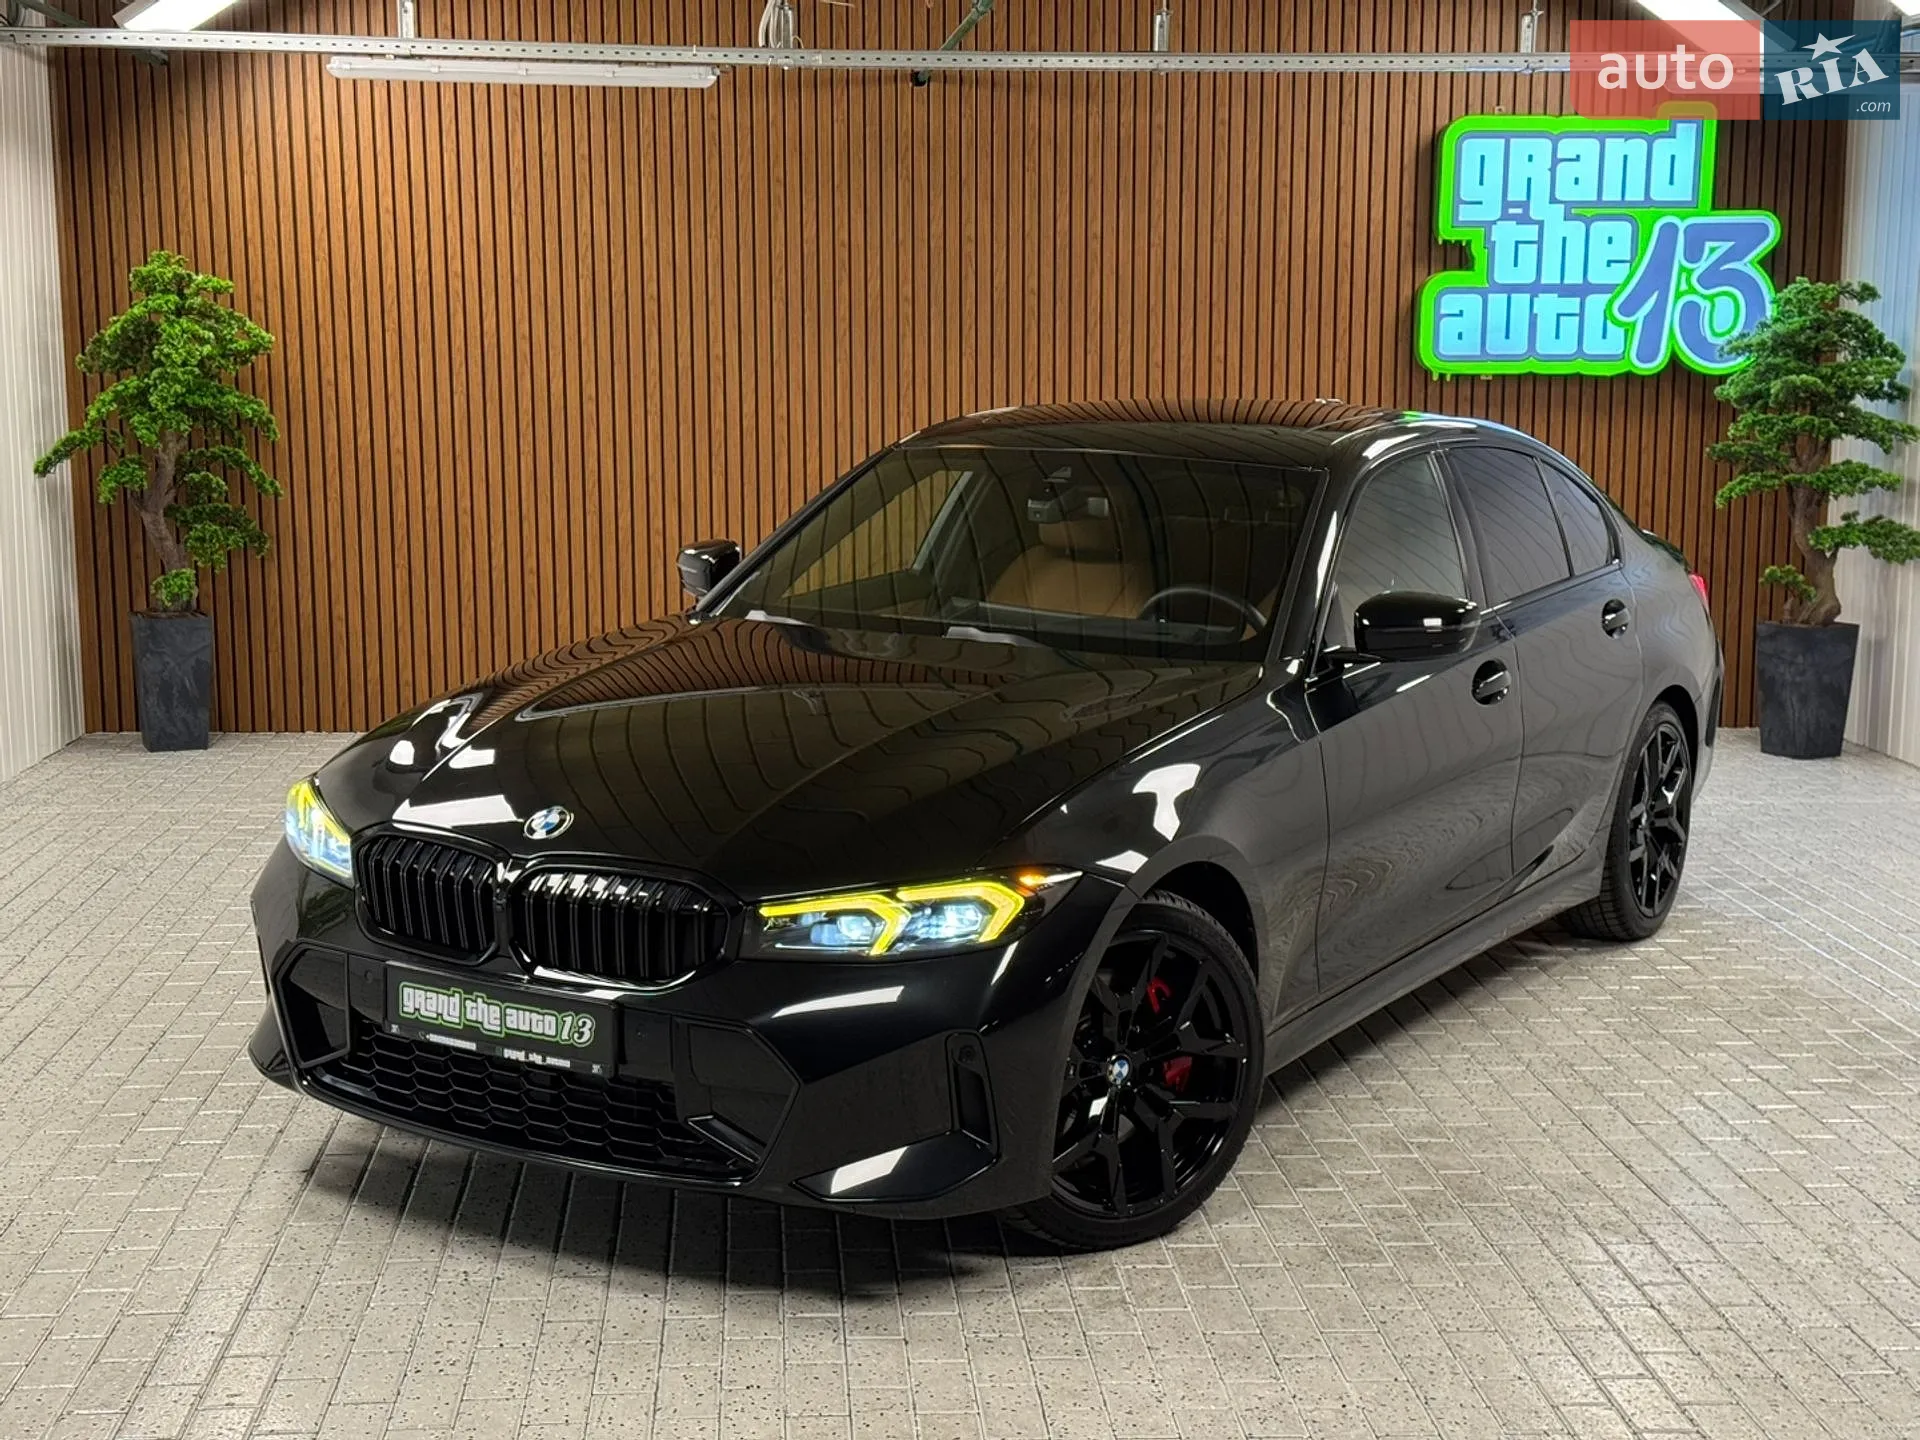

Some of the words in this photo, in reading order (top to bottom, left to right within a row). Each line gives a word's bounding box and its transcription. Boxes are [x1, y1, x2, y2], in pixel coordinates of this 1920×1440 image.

[1492, 206, 1632, 285] the
[1610, 217, 1773, 368] 13
[465, 996, 501, 1032] the
